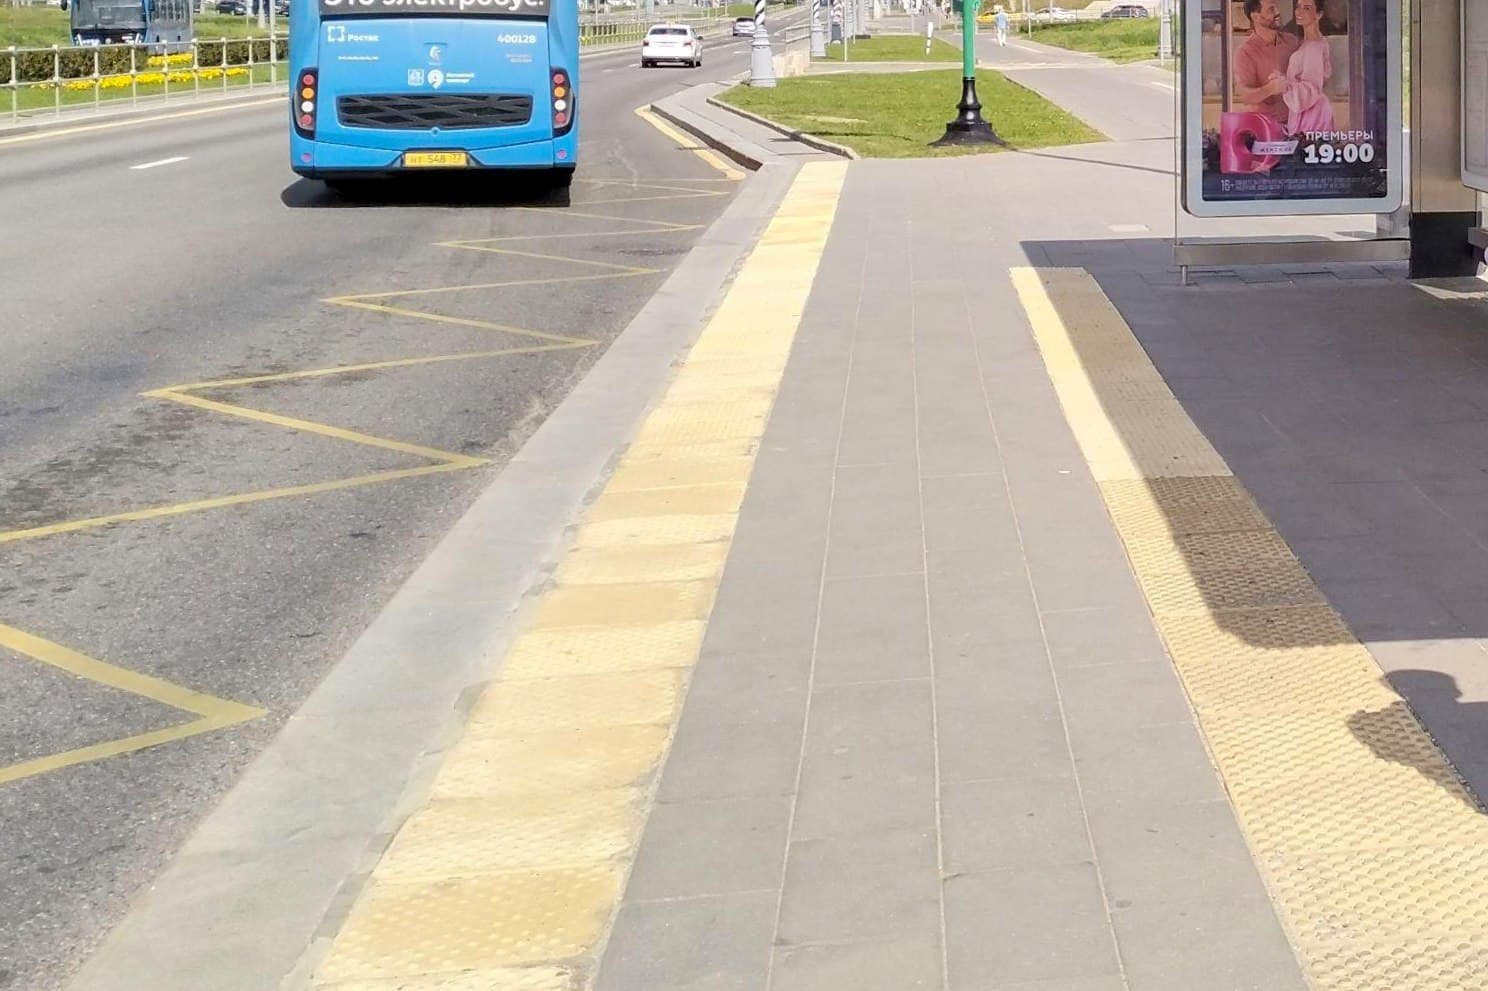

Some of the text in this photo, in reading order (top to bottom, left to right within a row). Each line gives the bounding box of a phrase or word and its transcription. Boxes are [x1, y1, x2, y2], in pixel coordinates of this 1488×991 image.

[497, 33, 537, 44] 400128
[1305, 130, 1374, 141] ПРЕМЬЕРЫ
[1304, 143, 1375, 164] 19:00
[1221, 179, 1236, 192] 16+
